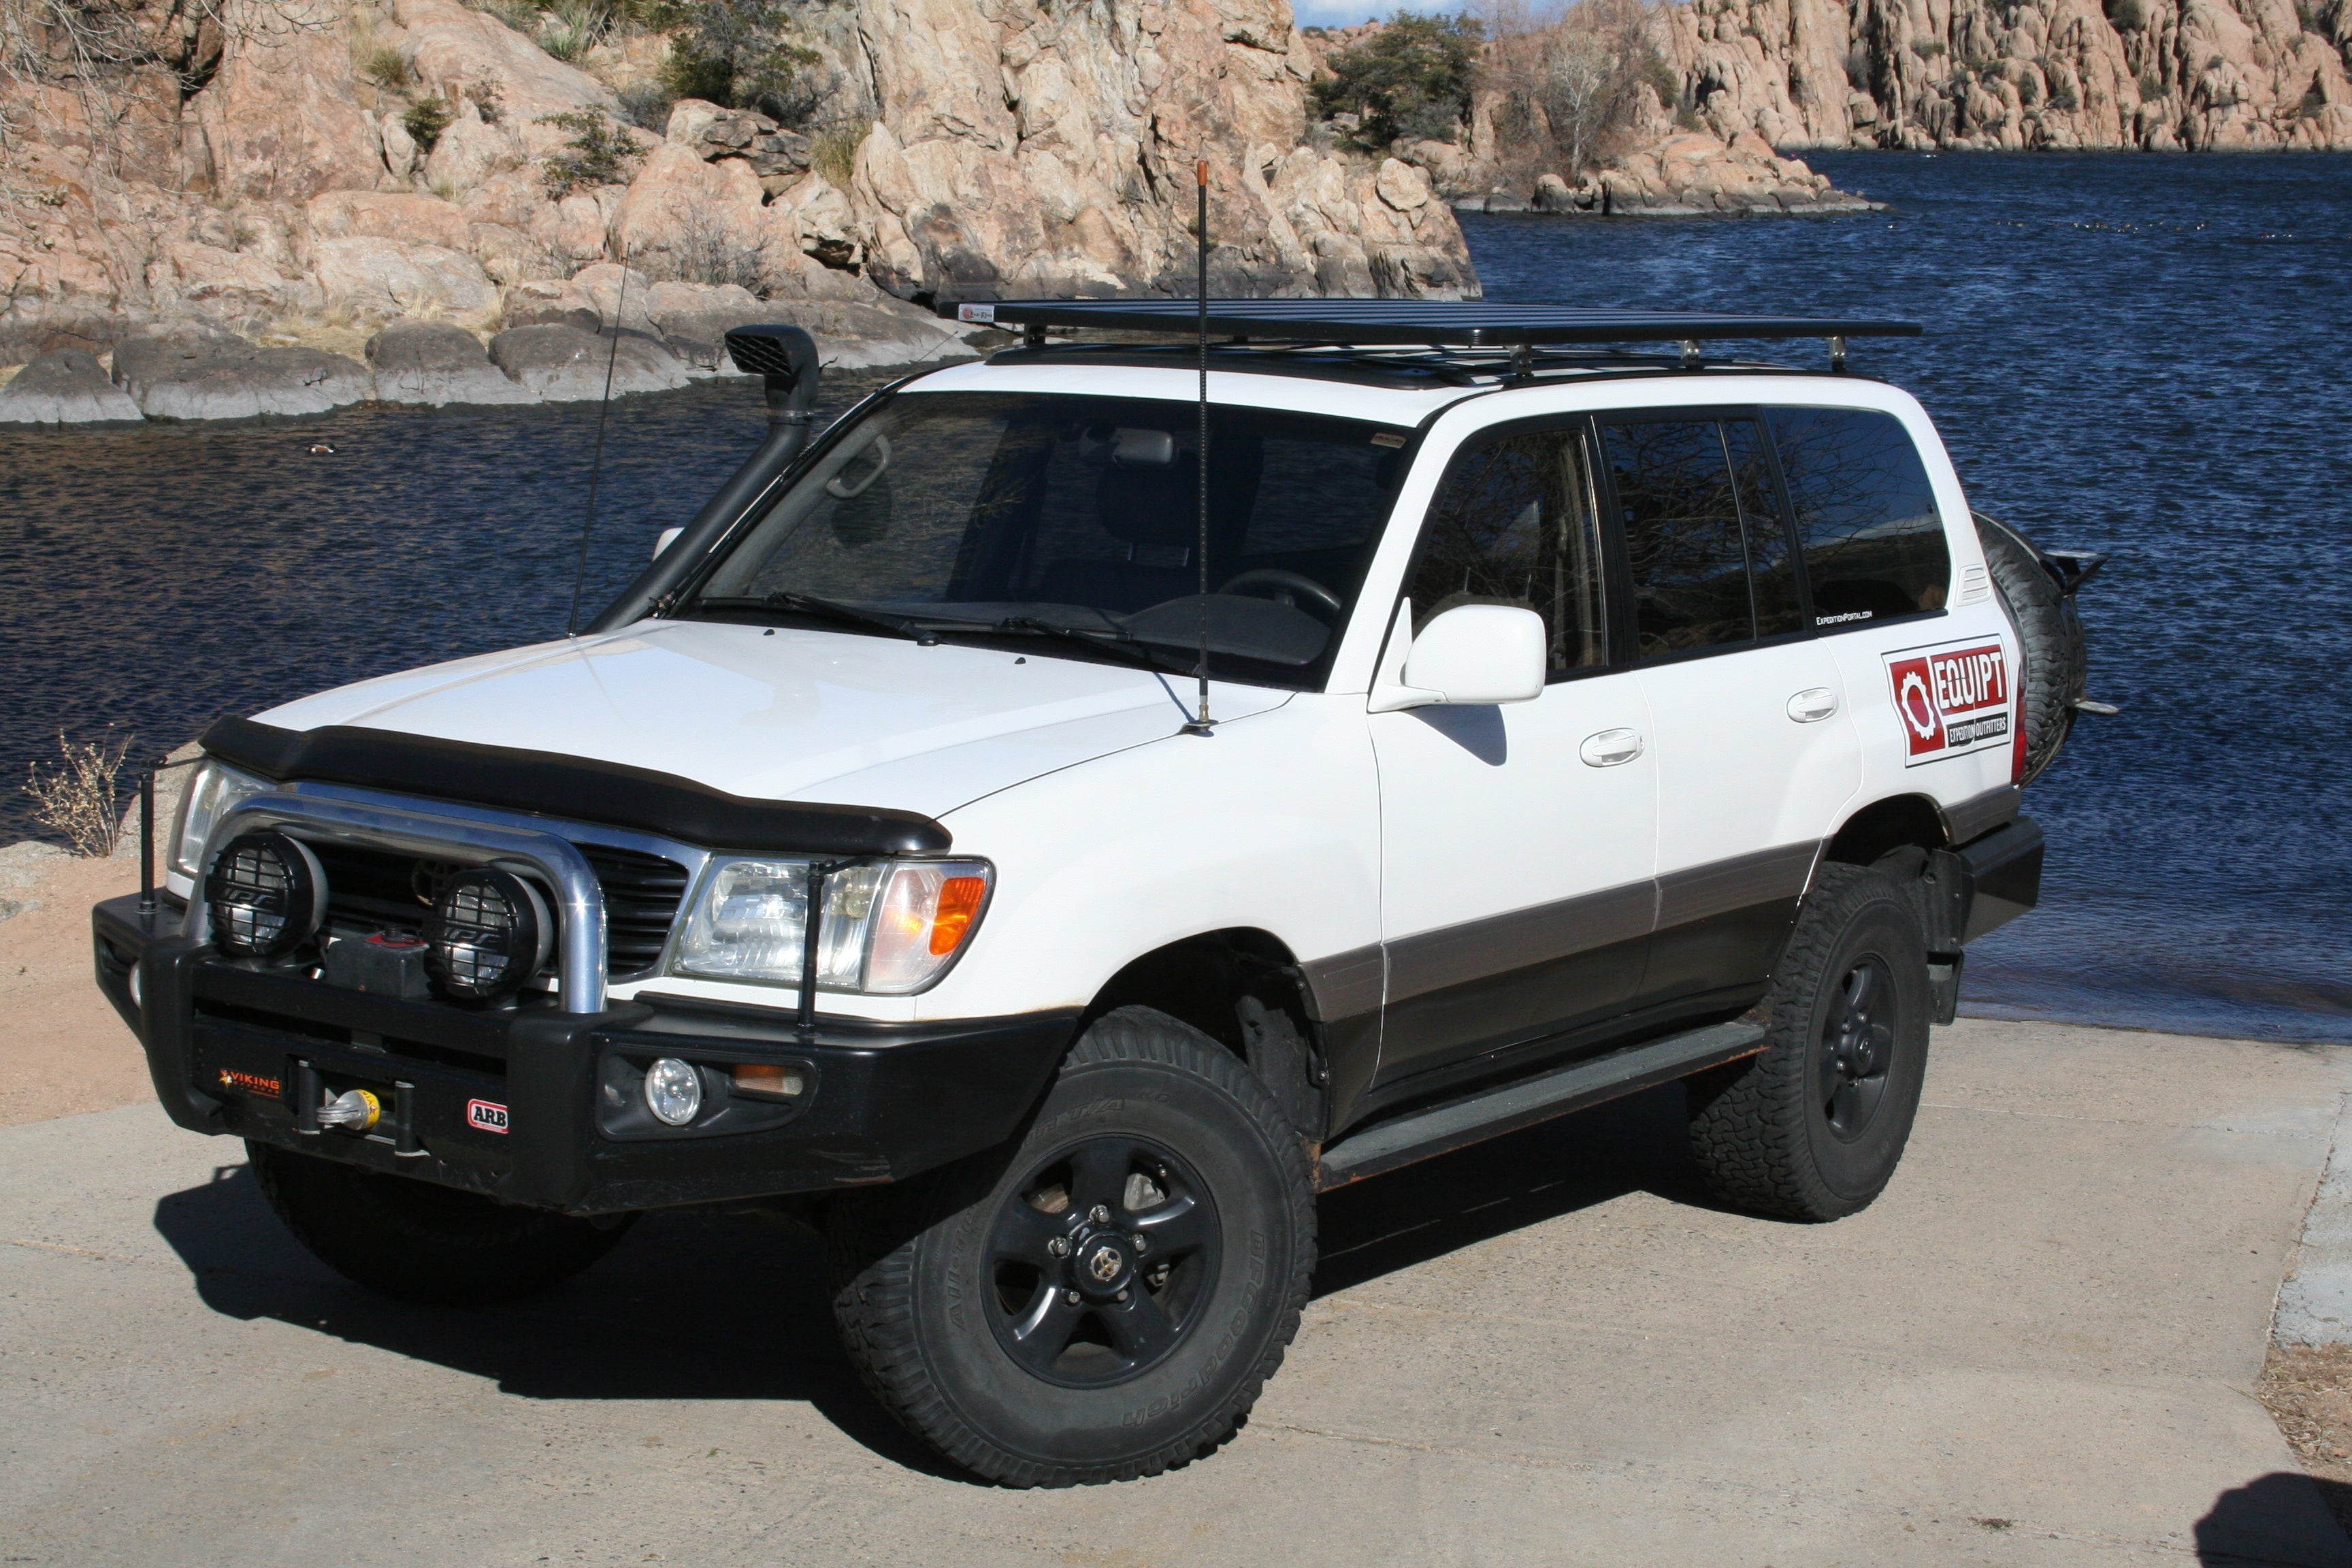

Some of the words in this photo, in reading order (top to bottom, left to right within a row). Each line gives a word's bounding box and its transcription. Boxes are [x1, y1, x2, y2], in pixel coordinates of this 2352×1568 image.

[1933, 651, 2003, 710] EQUIPT
[1976, 717, 2007, 737] OUTFITTERS
[230, 1071, 280, 1090] VIKING
[473, 1105, 507, 1128] ARB
